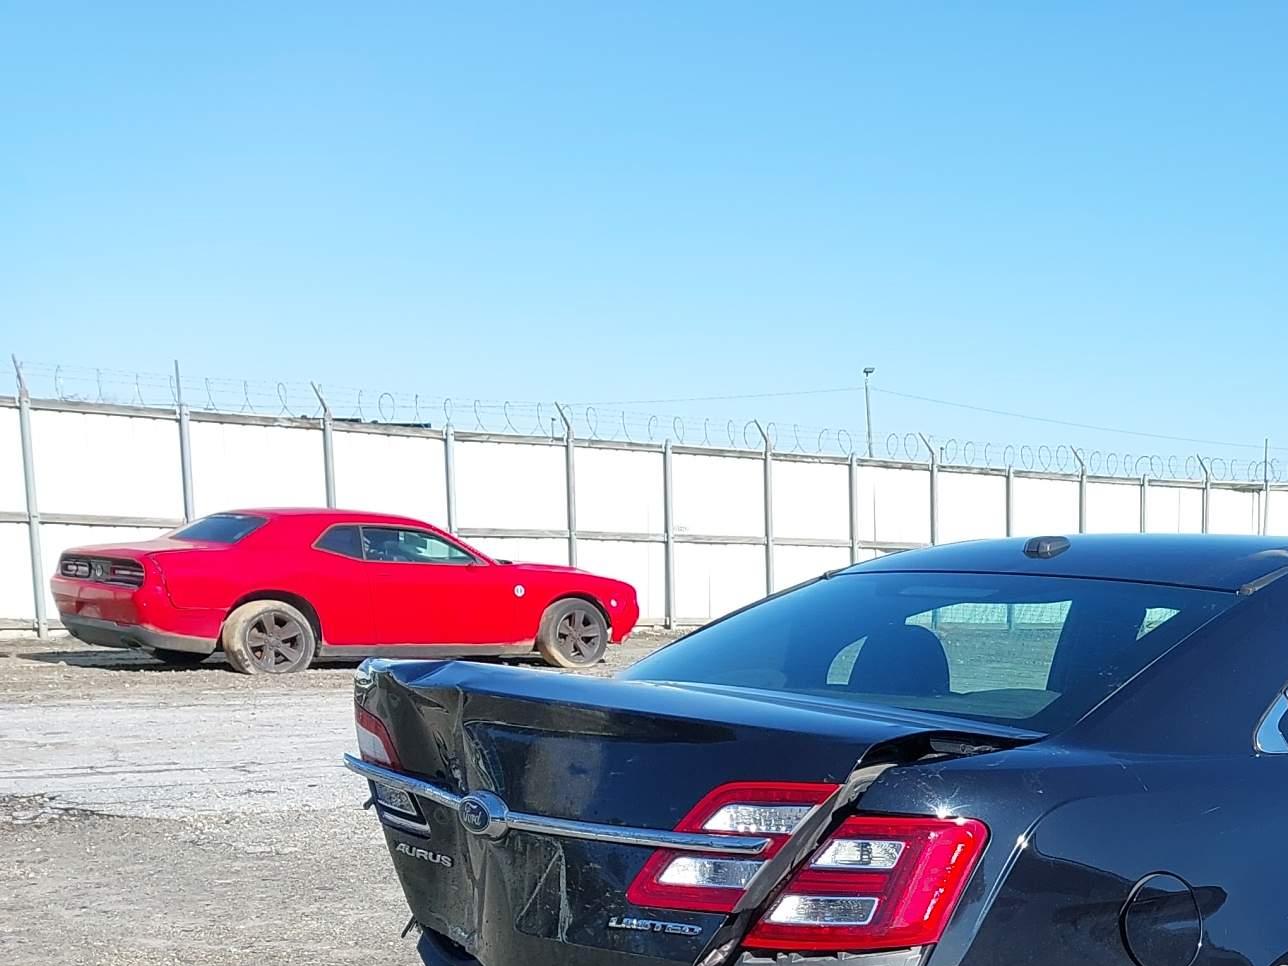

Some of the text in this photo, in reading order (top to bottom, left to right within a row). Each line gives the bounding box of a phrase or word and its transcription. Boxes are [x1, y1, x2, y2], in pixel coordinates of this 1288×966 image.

[463, 801, 482, 826] Ford
[395, 842, 453, 868] AURUS
[608, 916, 703, 936] LIMITED
